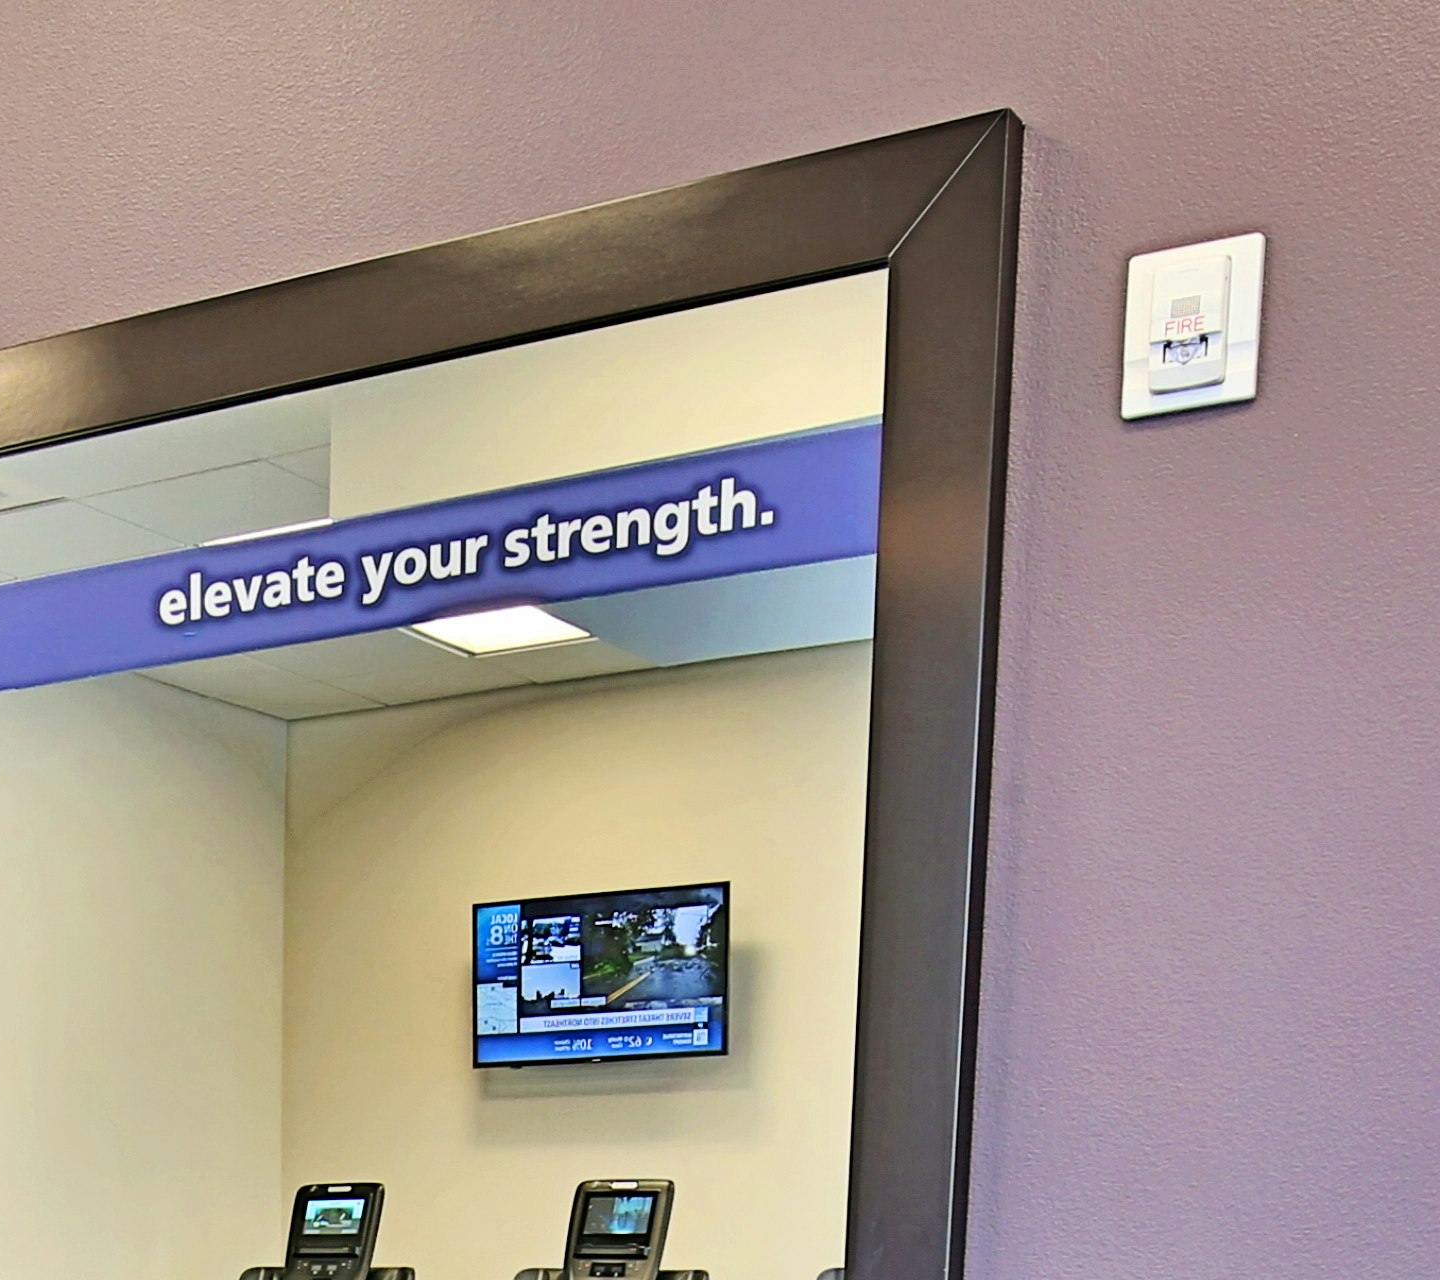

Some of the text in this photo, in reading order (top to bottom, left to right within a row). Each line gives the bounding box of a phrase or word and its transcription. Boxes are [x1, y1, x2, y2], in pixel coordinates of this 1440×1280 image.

[1164, 315, 1206, 337] FIRE
[158, 477, 775, 627] elevate your strength.
